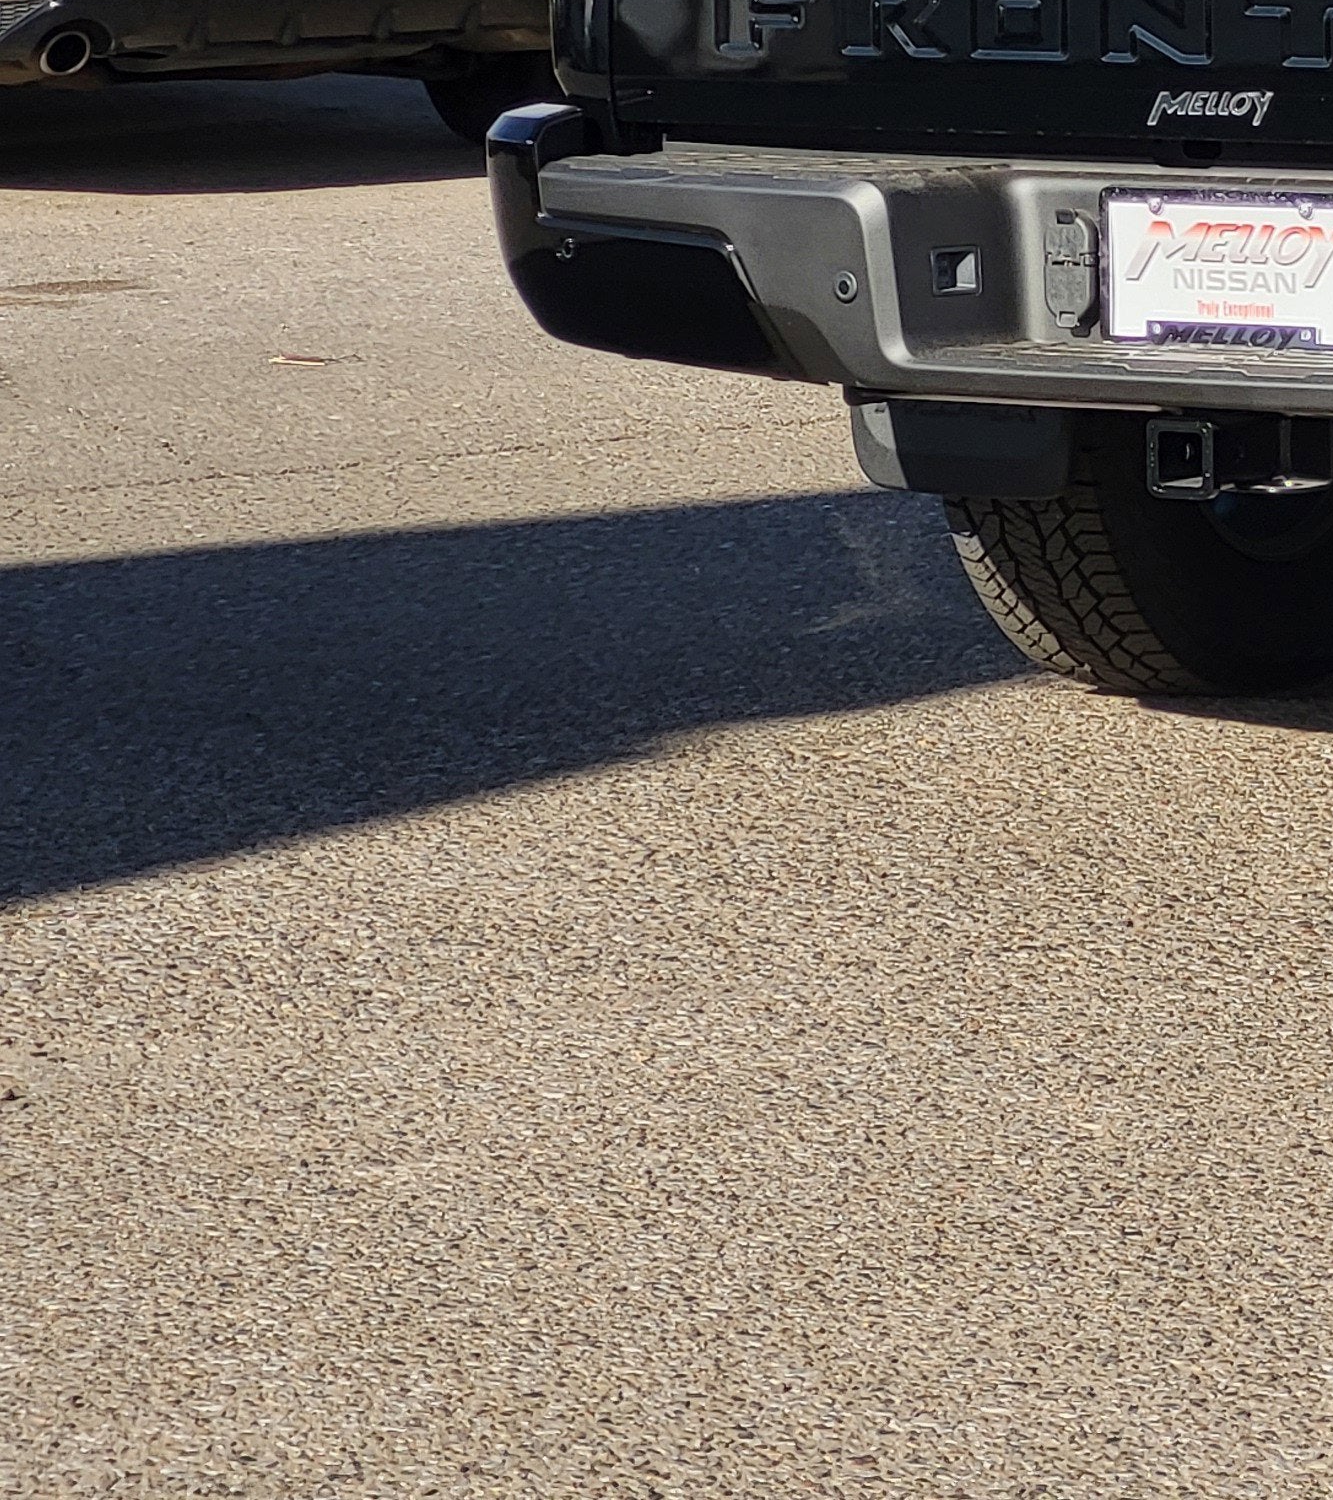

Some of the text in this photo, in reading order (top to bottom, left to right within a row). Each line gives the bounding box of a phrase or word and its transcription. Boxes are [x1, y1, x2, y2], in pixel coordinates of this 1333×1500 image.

[1146, 90, 1275, 127] MELLOY
[1173, 267, 1297, 295] NISSAN
[1197, 299, 1220, 318] Truly
[1155, 325, 1299, 350] MELLOY
